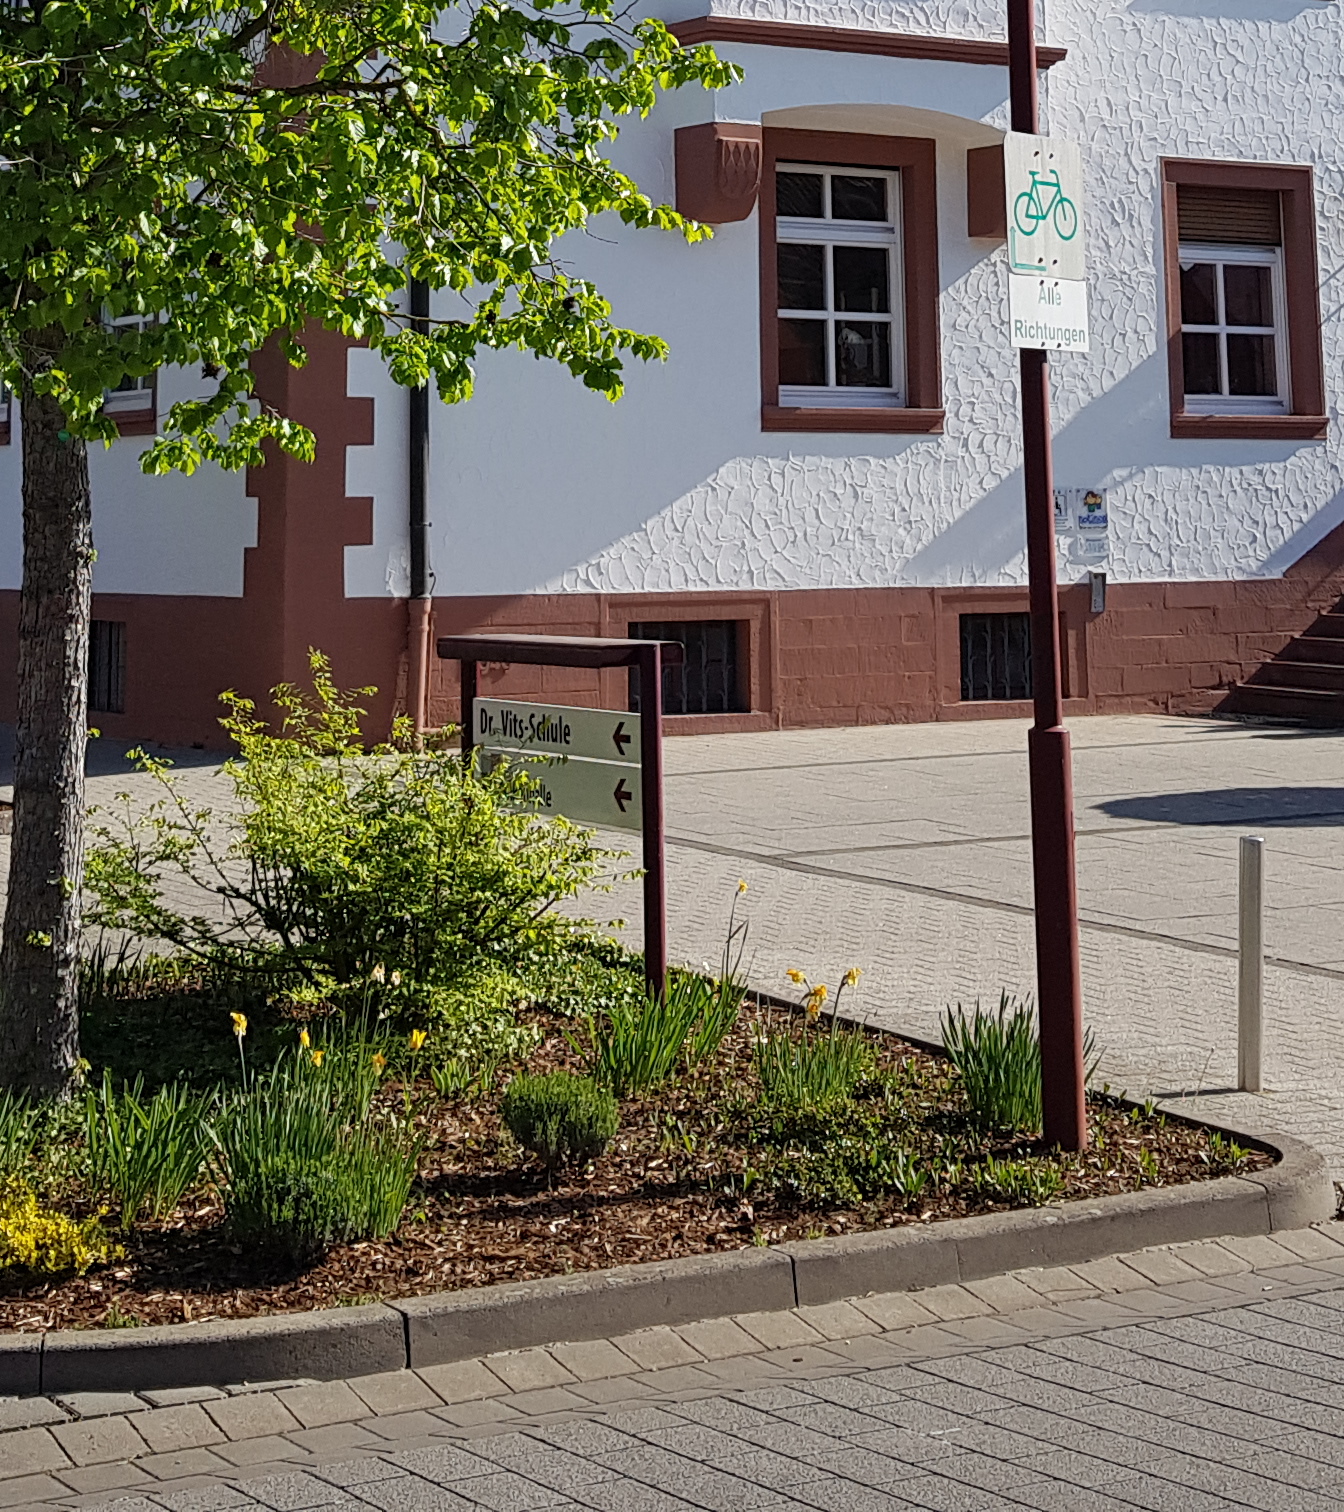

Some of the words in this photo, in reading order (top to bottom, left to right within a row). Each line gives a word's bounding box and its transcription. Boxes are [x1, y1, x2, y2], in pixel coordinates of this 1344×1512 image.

[1037, 285, 1062, 306] Alle
[1013, 319, 1086, 347] Richtungen
[500, 709, 571, 745] Vits-Schule
